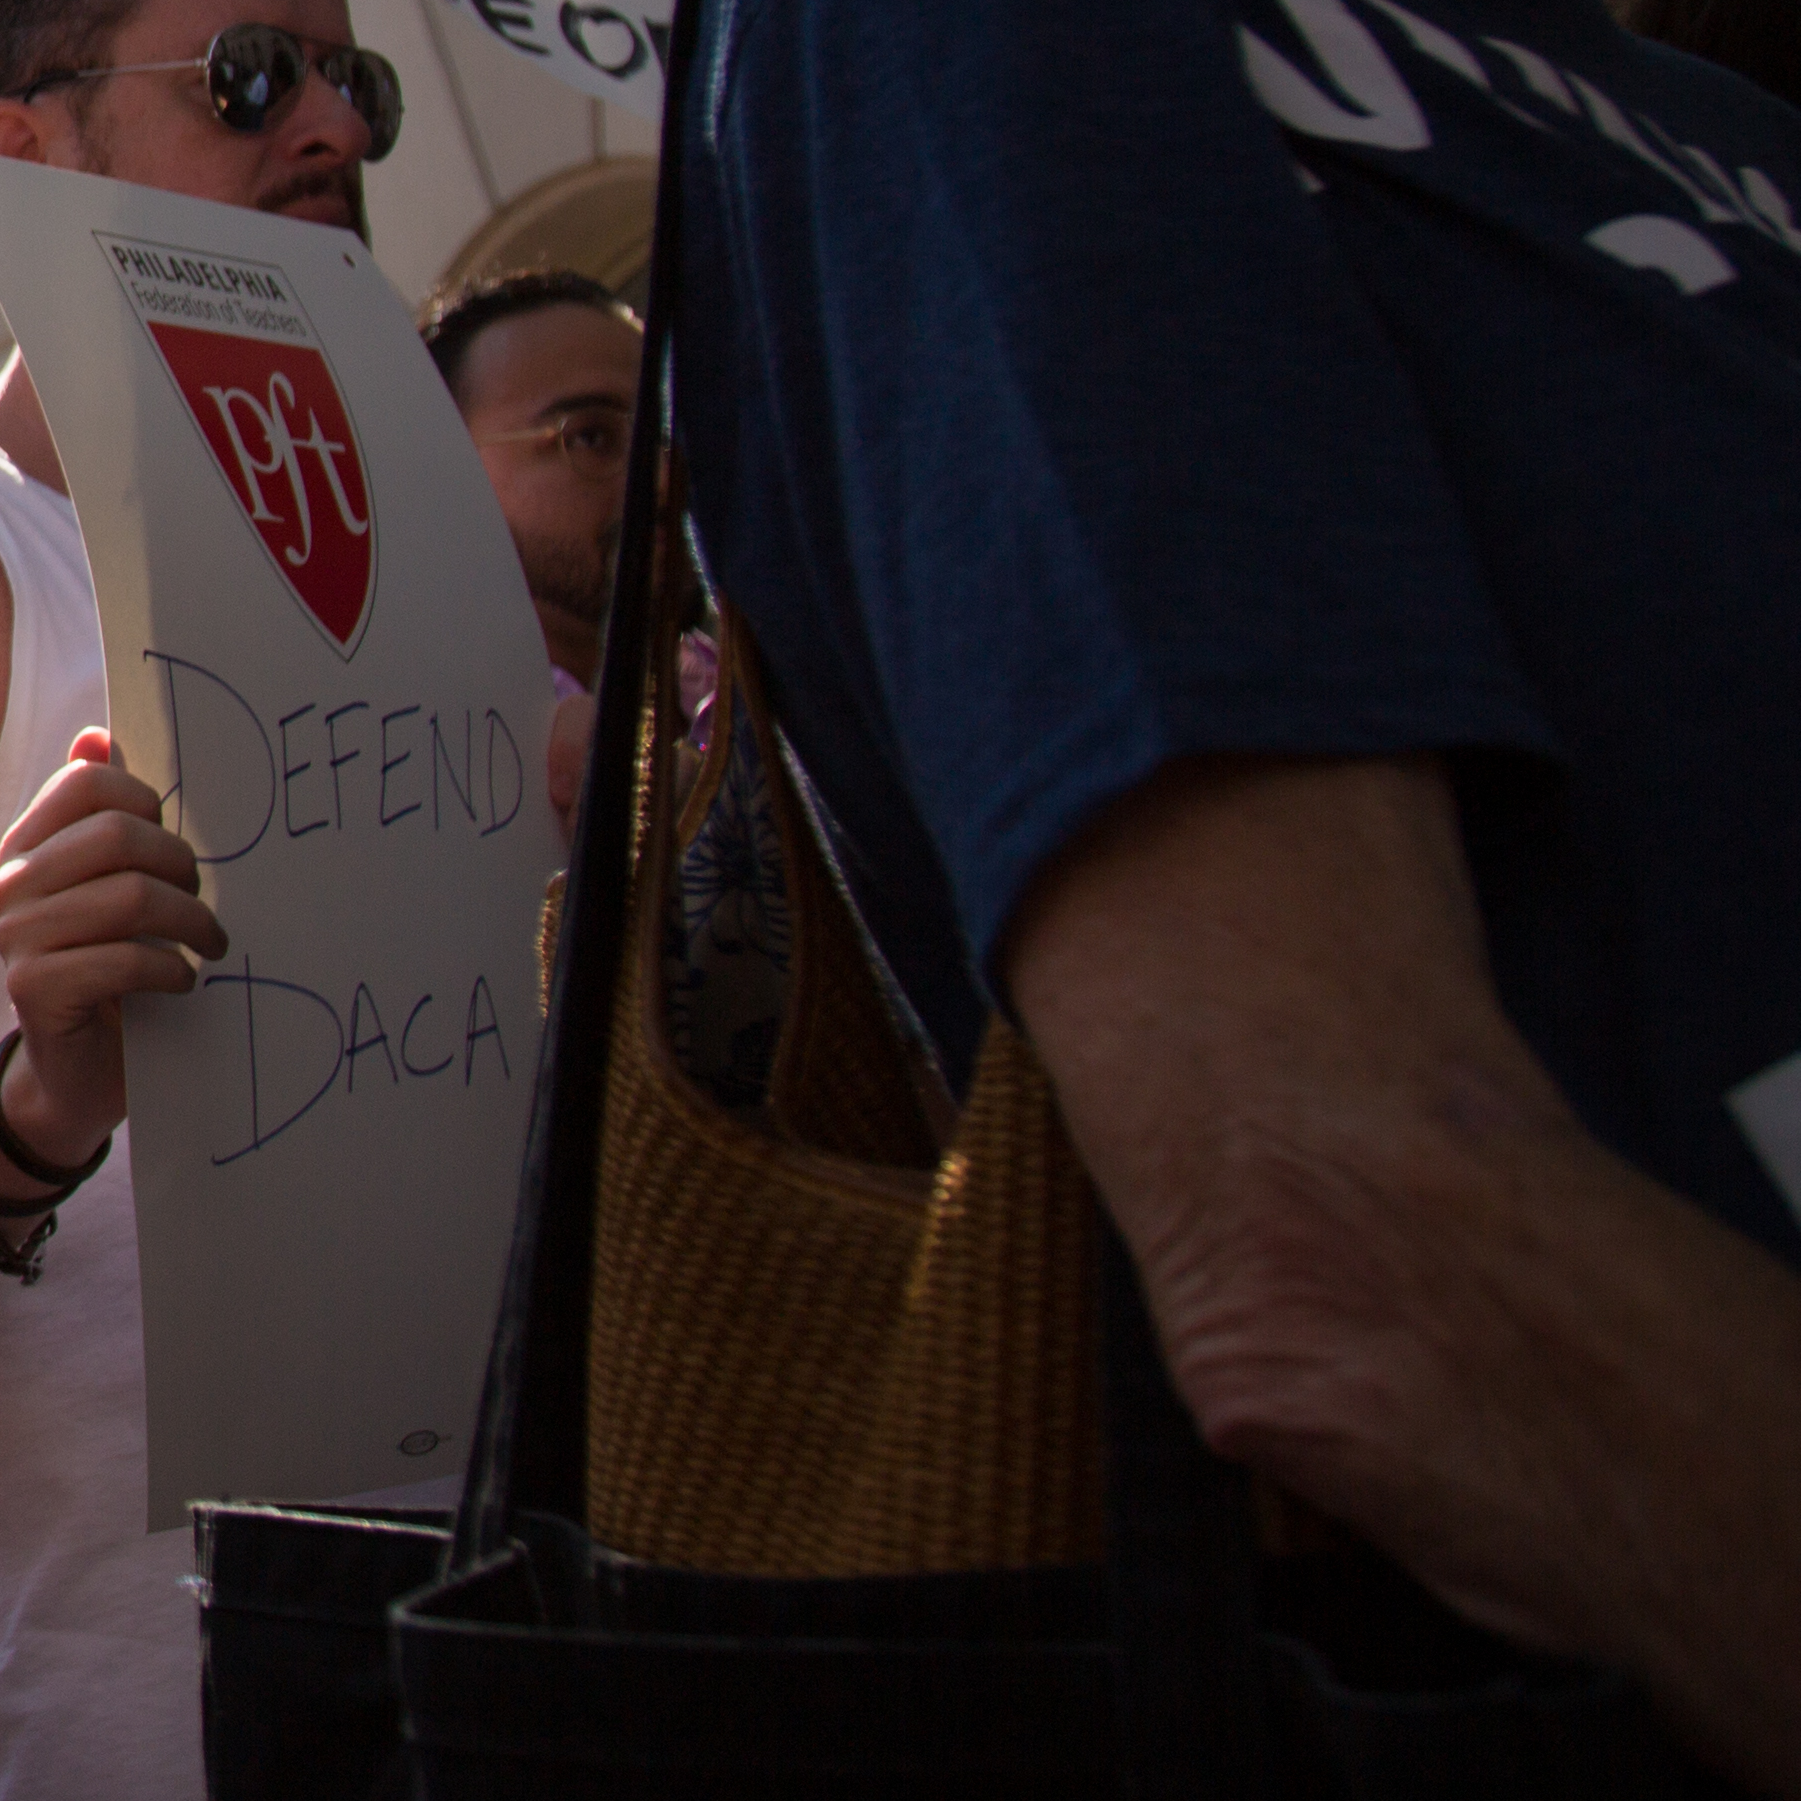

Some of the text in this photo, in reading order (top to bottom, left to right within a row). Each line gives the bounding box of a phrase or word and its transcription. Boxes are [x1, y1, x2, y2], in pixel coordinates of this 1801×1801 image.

[111, 245, 287, 302] PHILADELPHIA
[130, 280, 220, 321] Federation
[233, 299, 308, 337] Teachers
[201, 370, 368, 567] pft
[143, 649, 524, 864] DEFEND
[203, 952, 511, 1166] DACA
